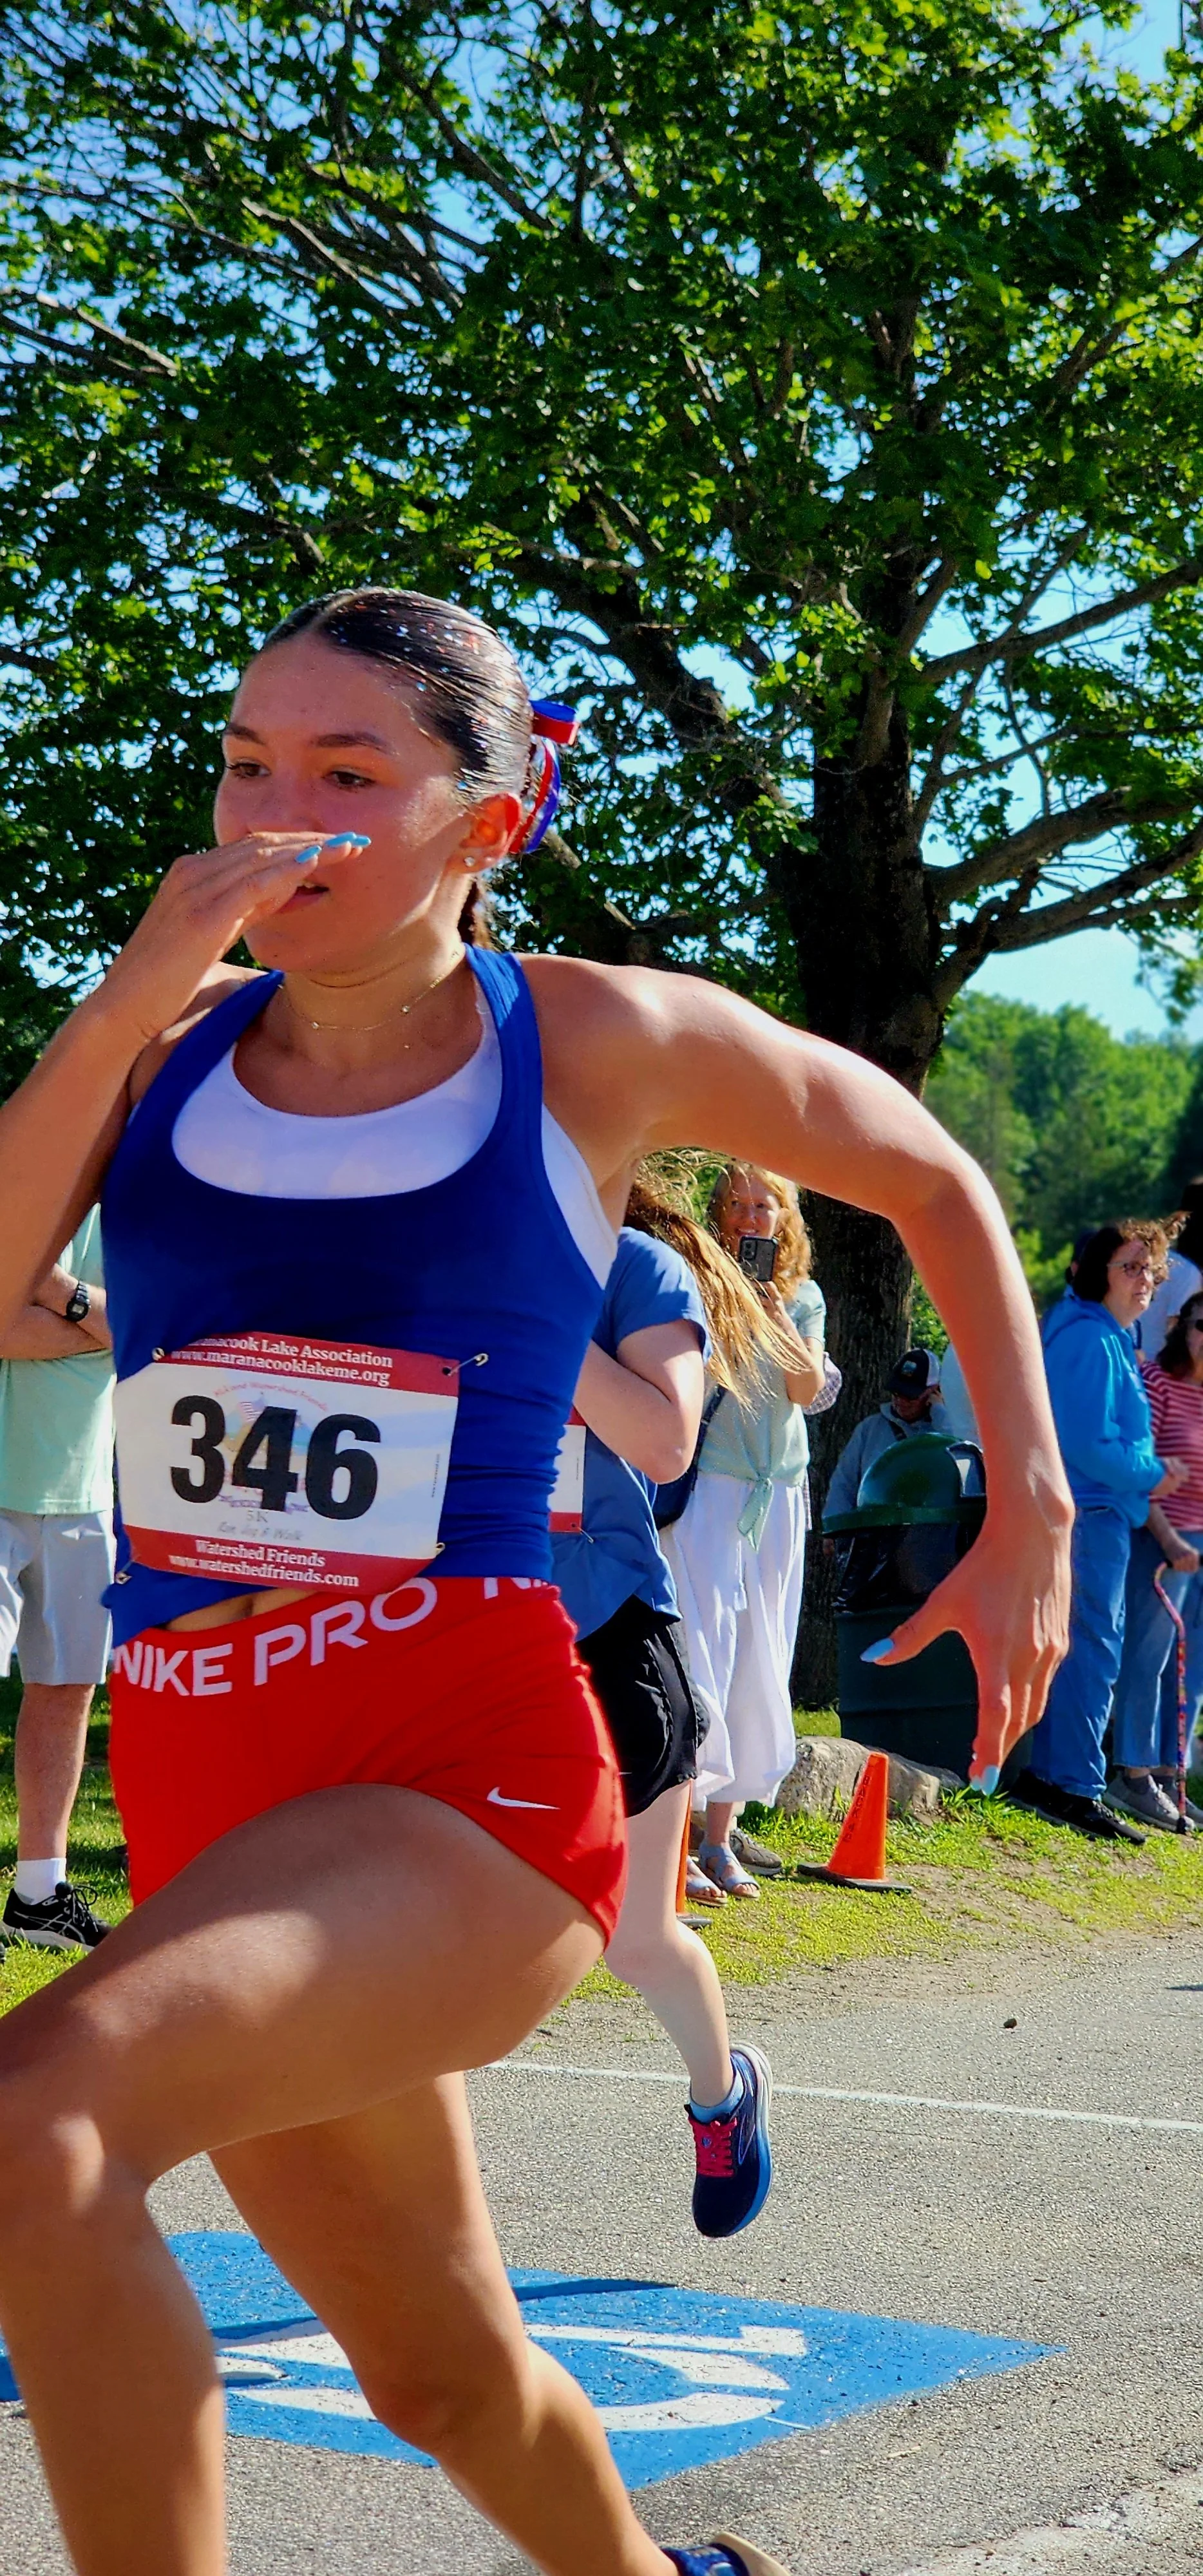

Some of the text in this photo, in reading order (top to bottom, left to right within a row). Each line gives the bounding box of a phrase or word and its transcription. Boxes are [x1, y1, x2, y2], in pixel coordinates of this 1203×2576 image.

[171, 1350, 391, 1387] www.maranacooklakeme.org
[261, 1339, 299, 1356] Lake
[300, 1345, 393, 1368] Association
[170, 1395, 381, 1520] 346
[195, 1539, 327, 1567] Watershed Friends
[168, 1555, 359, 1587] www.watershedfriends.com
[113, 1578, 438, 1696] NIKE PRO
